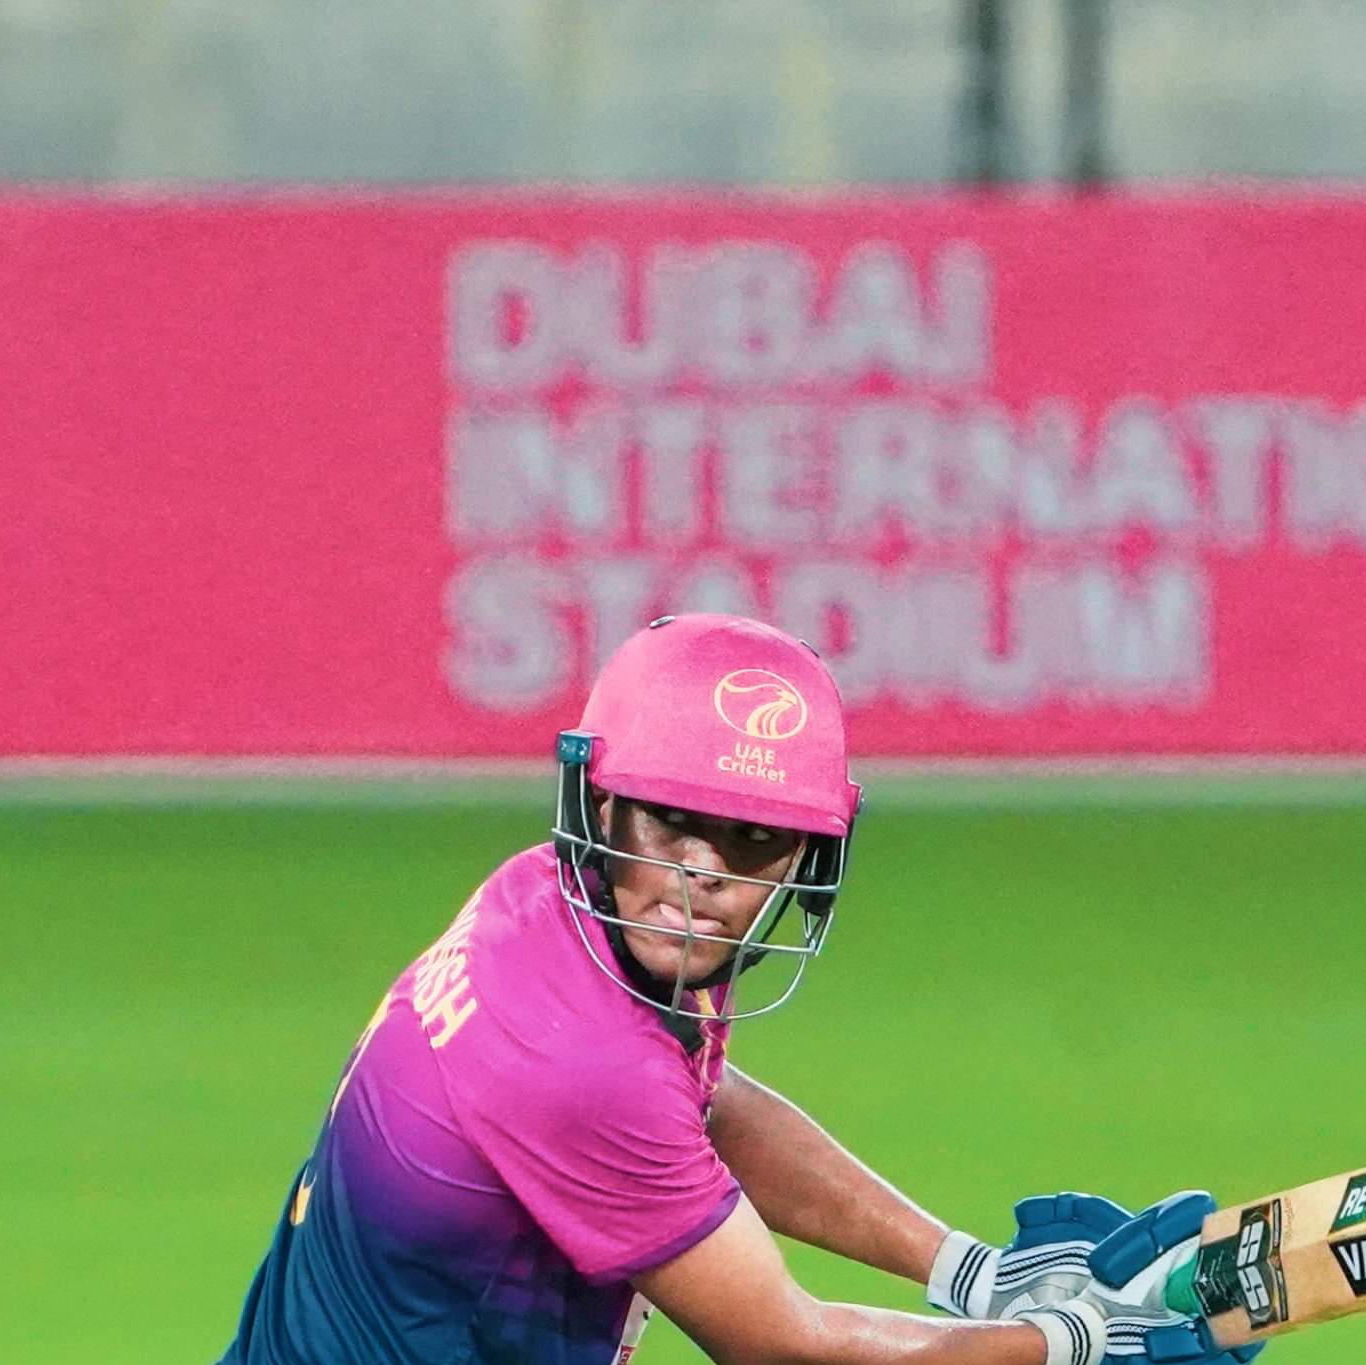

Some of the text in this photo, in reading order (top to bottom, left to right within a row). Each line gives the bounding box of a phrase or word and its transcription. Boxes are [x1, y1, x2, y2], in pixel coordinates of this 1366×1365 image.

[447, 240, 991, 386] DUBAI
[735, 742, 775, 765] UAE
[717, 755, 786, 784] Cricket
